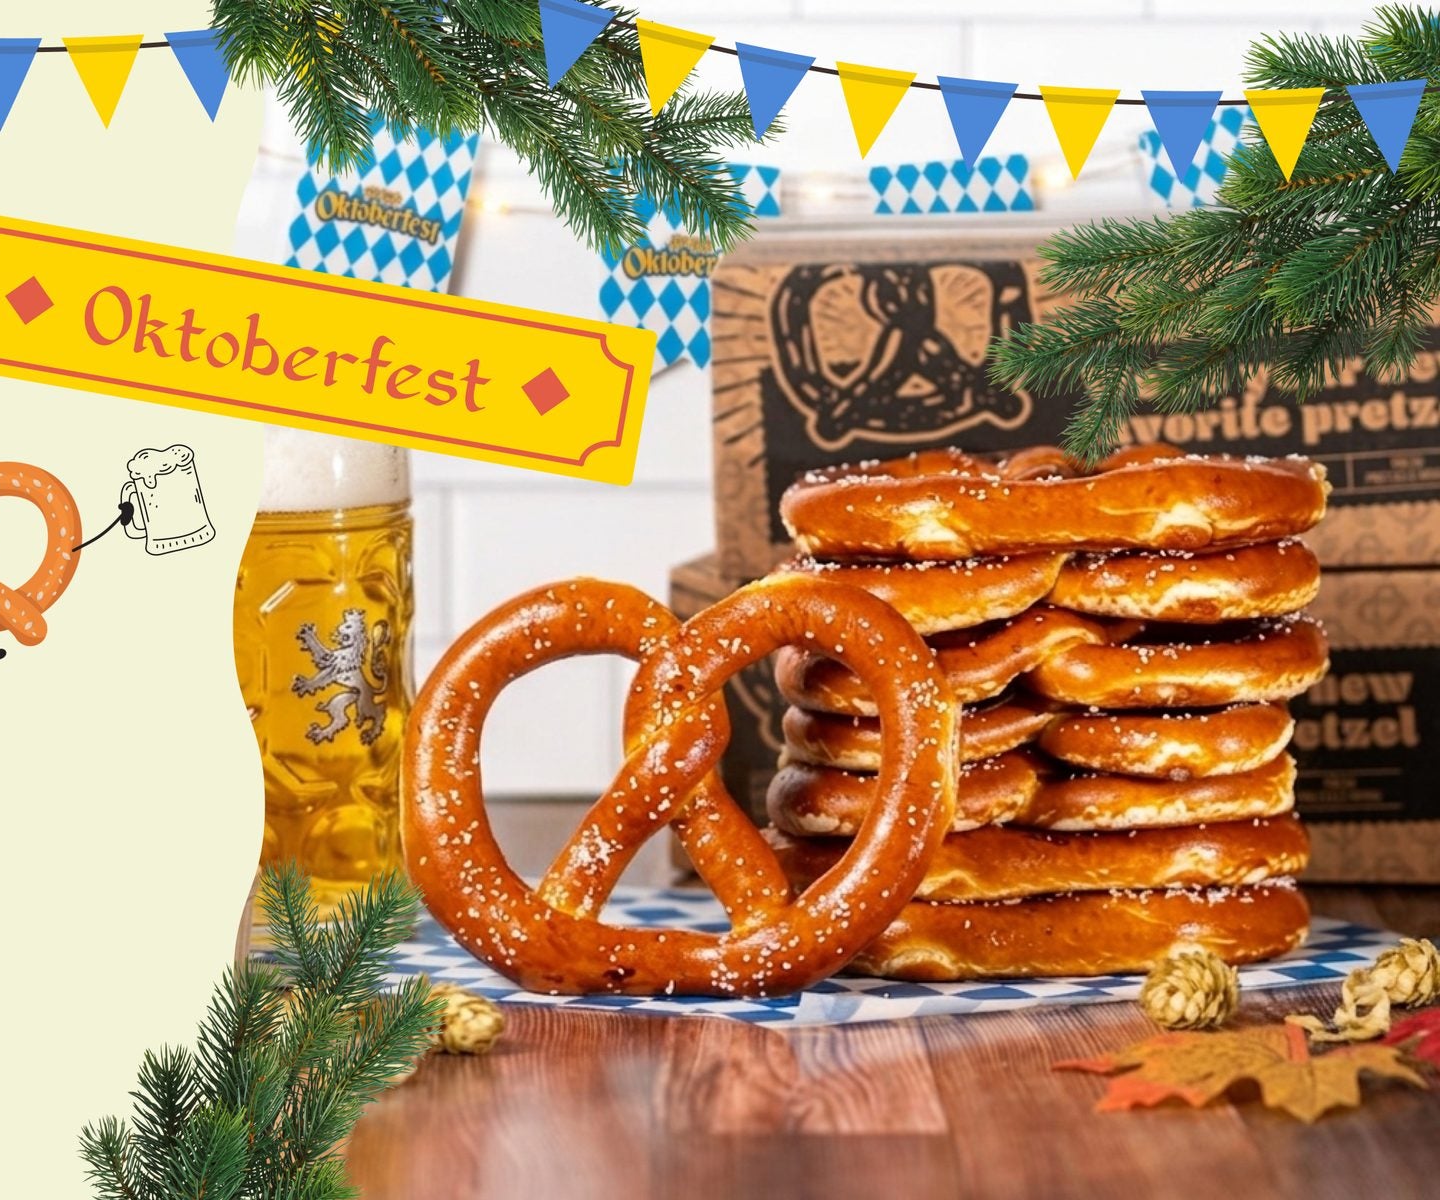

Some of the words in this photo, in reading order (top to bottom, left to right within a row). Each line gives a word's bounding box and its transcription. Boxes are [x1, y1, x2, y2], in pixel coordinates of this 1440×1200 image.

[316, 189, 440, 244] Oktoberfest
[623, 246, 720, 279] Oktober
[1108, 396, 1291, 444] vorite
[1301, 391, 1440, 445] pretz
[1294, 705, 1421, 749] etzel
